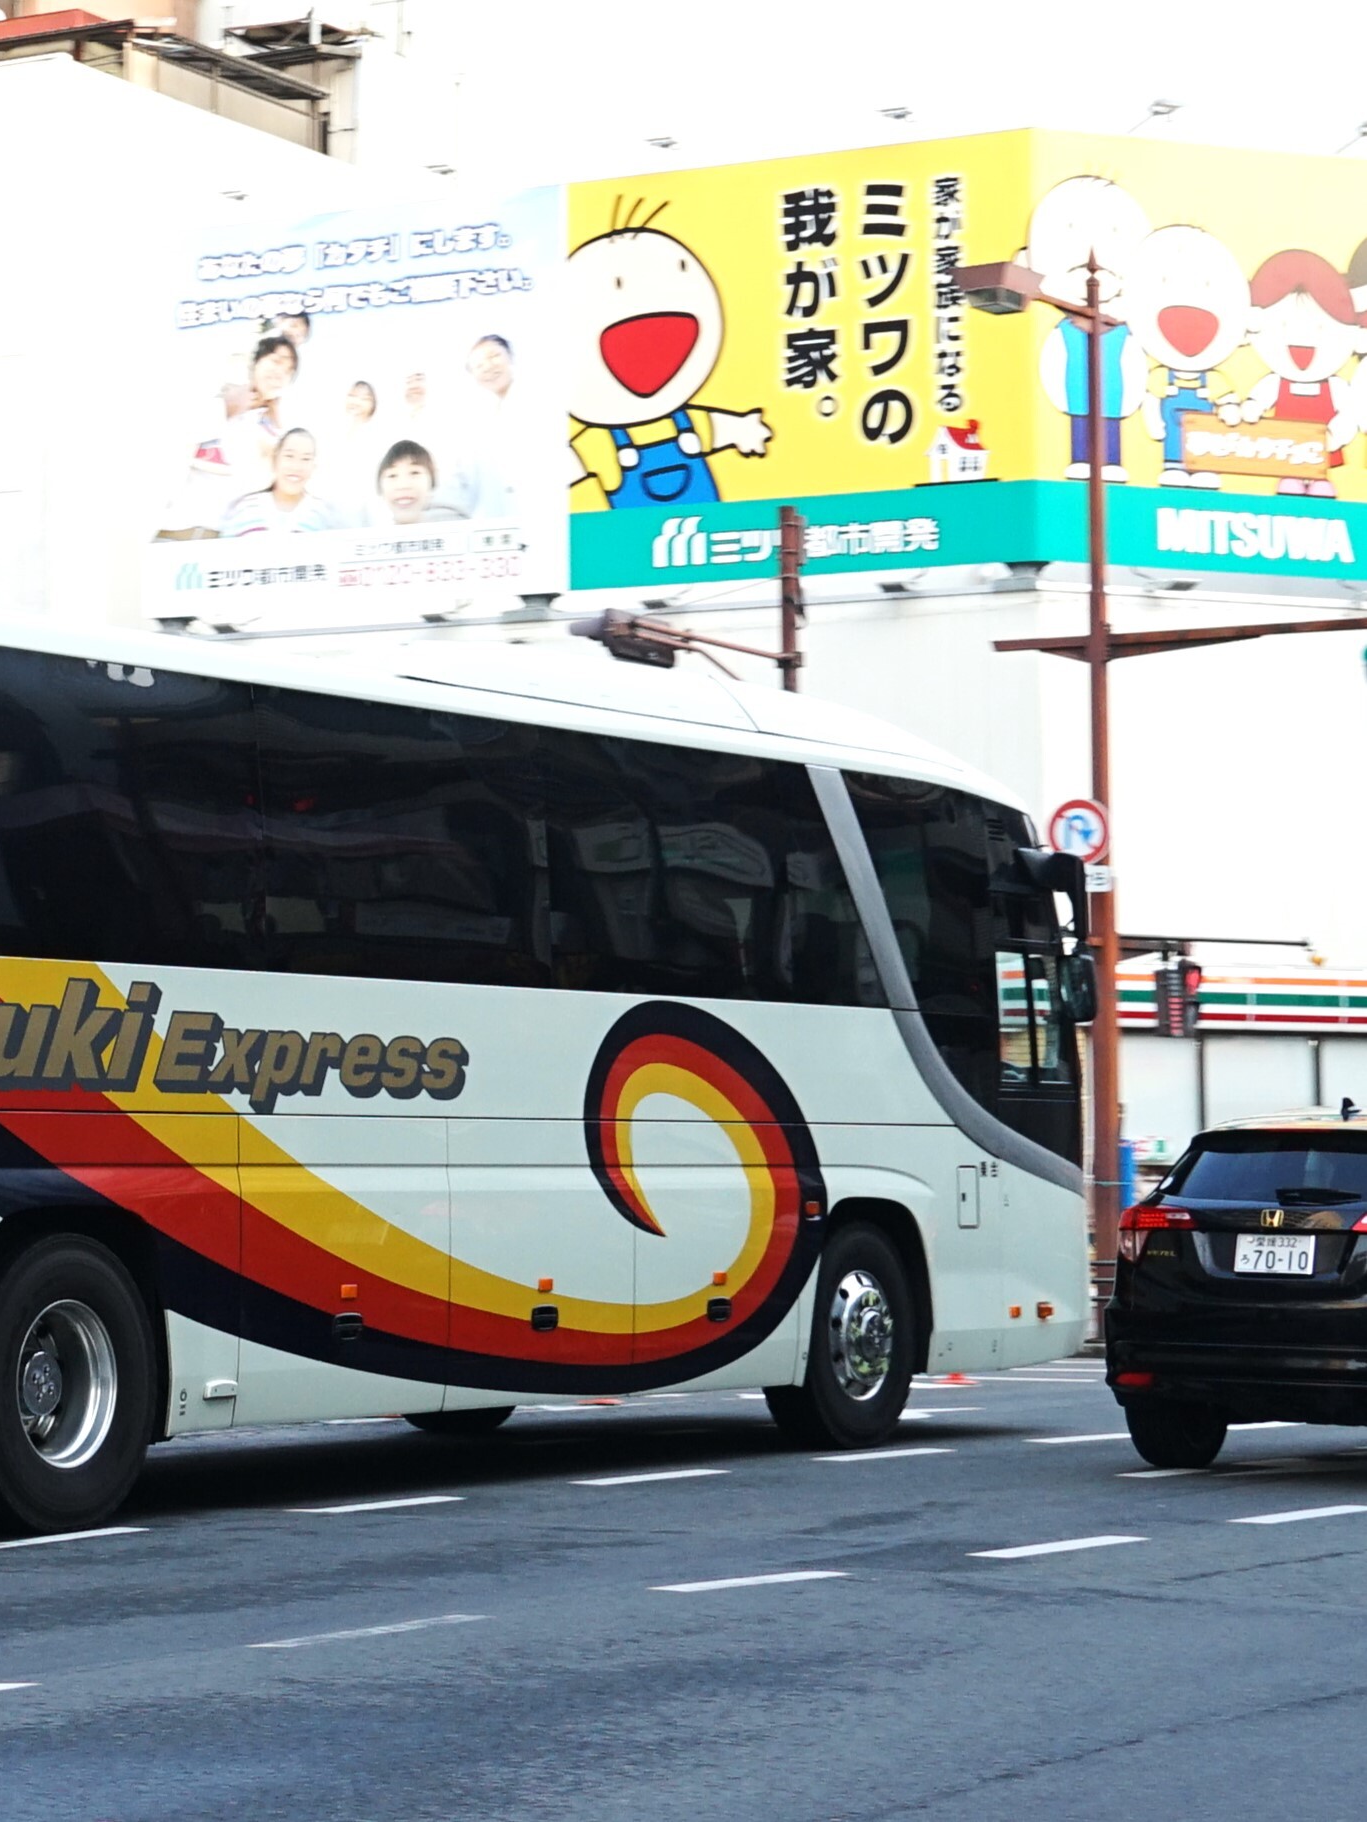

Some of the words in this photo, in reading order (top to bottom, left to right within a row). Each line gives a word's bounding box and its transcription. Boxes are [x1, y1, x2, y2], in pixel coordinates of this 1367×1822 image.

[781, 187, 840, 418] 我が家。
[860, 184, 913, 444] ミツワの
[1156, 507, 1356, 564] MITSUWA
[153, 1010, 470, 1114] Express
[1253, 1249, 1309, 1270] 70-10
